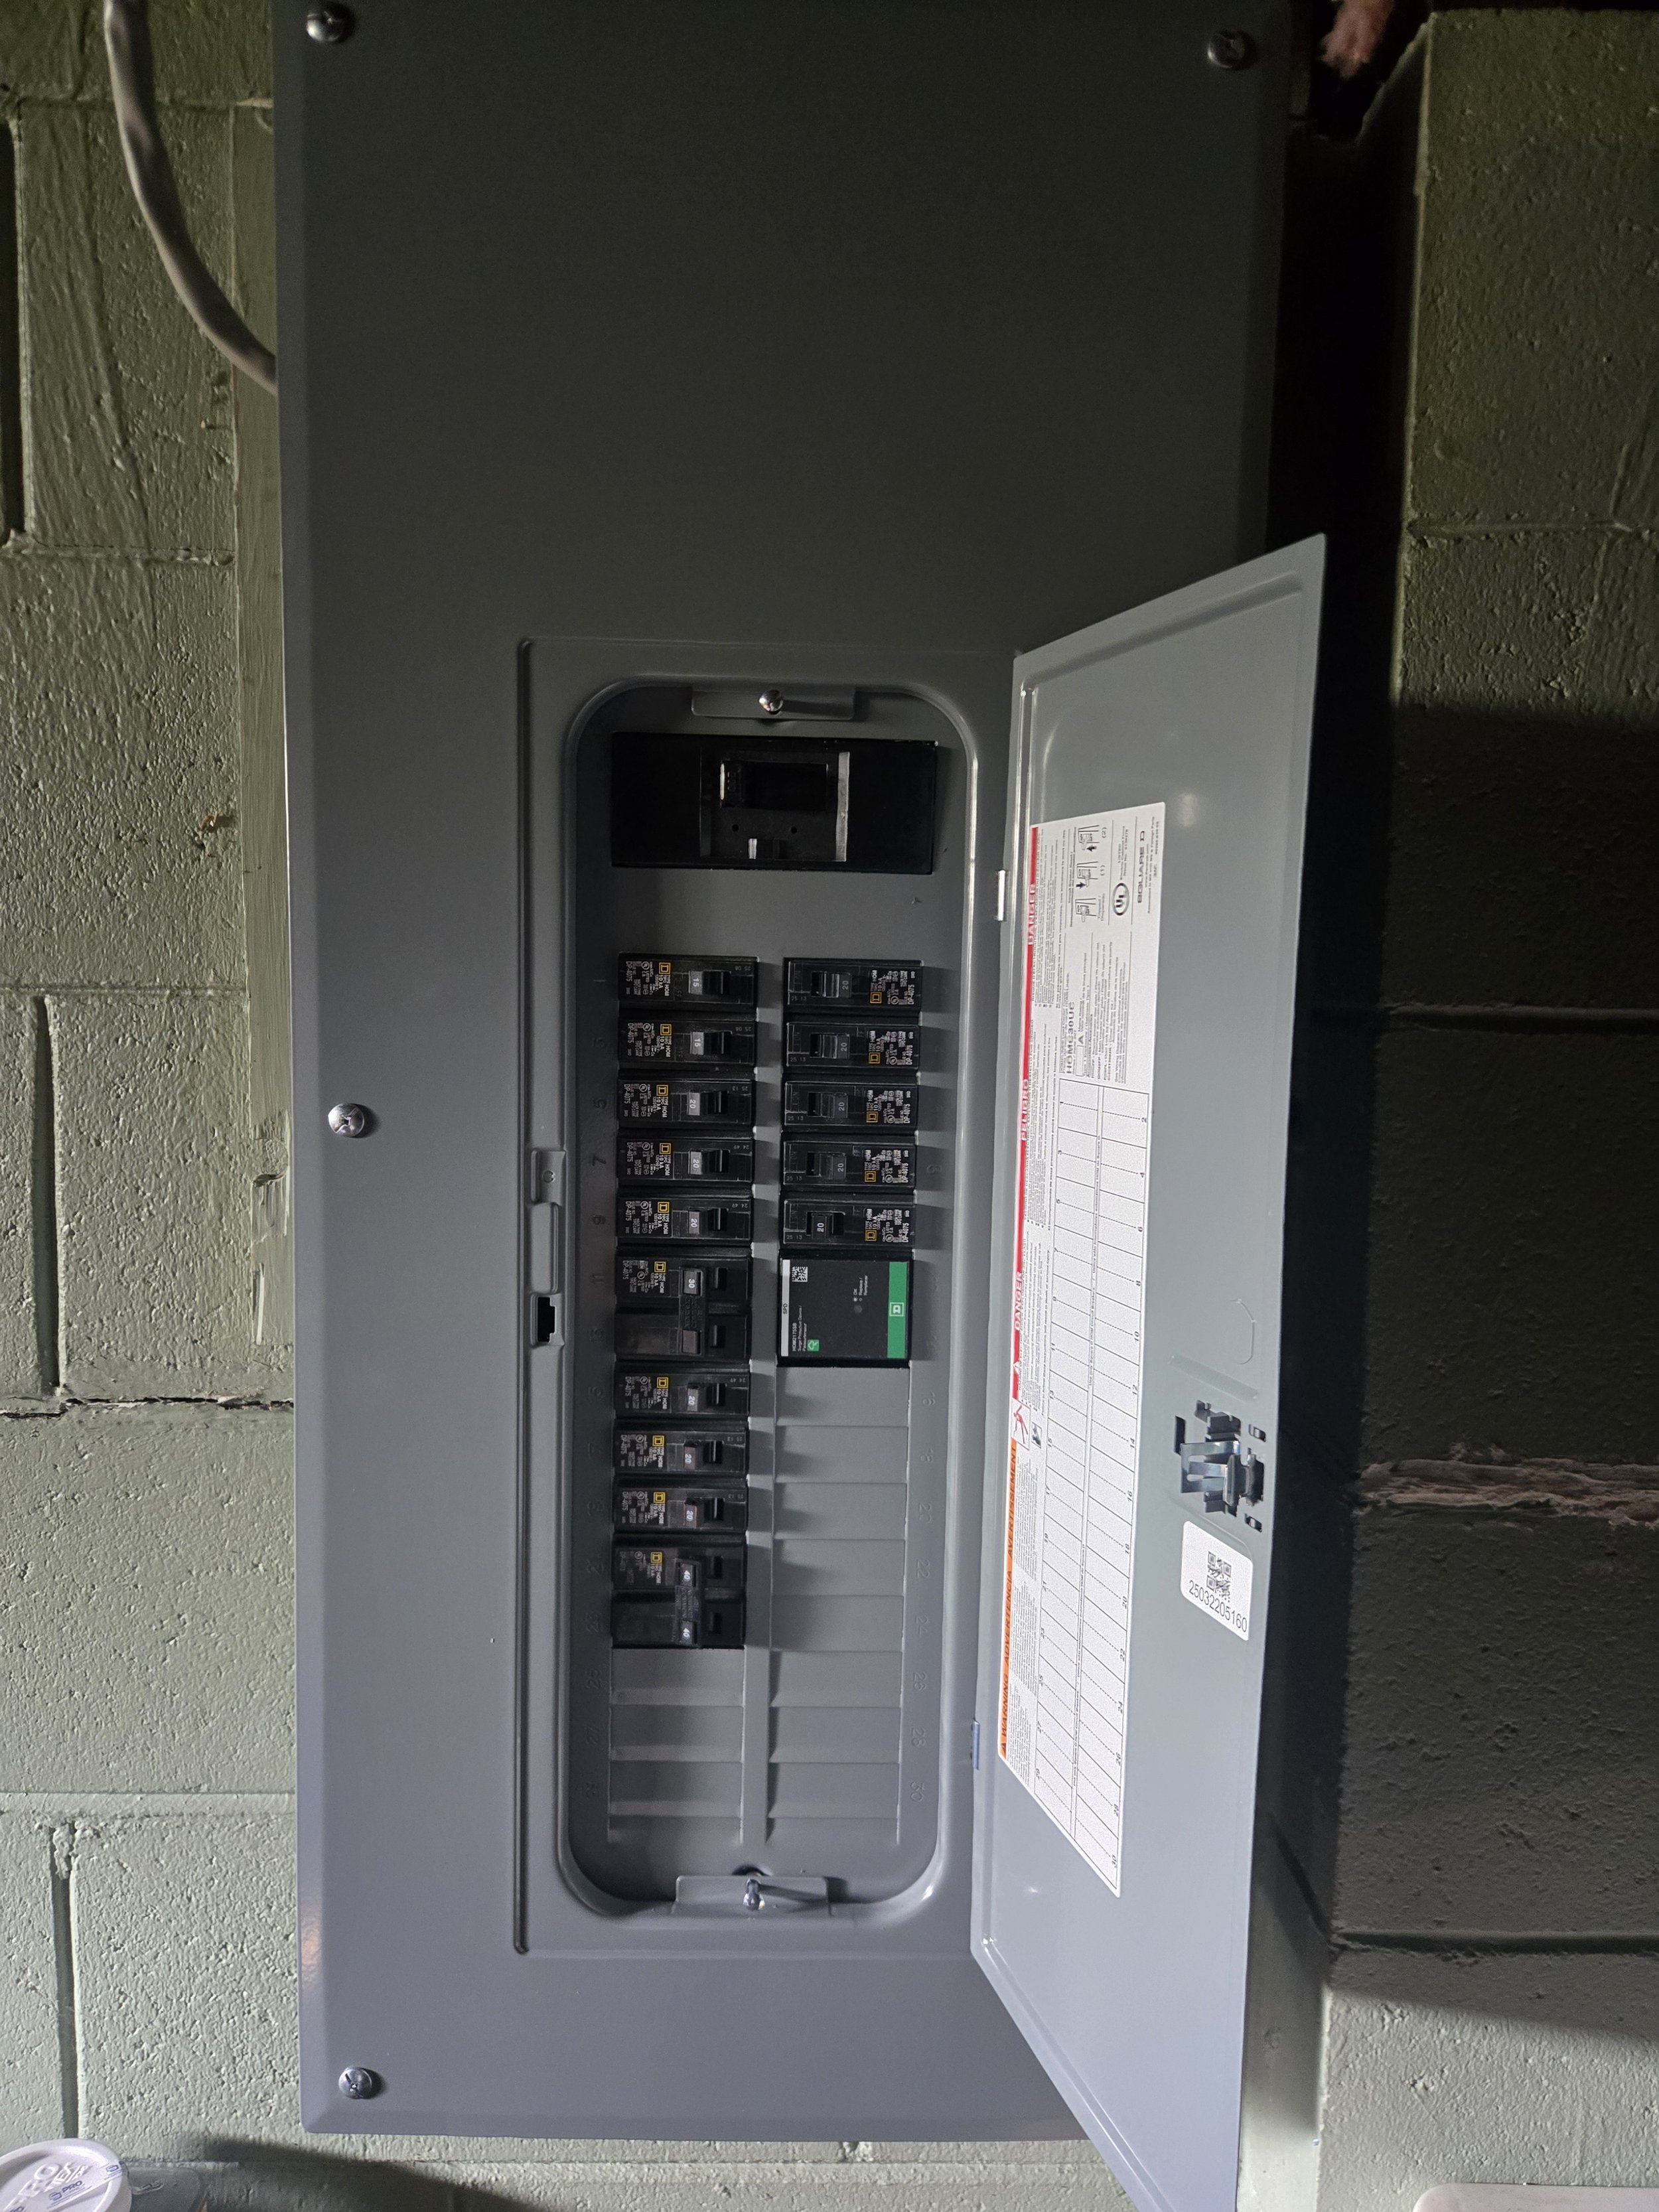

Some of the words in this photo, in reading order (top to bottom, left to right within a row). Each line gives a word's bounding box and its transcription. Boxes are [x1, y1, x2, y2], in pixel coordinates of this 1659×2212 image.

[1139, 830, 1145, 842] D
[693, 978, 699, 987] 15
[842, 980, 849, 990] 20
[694, 1038, 701, 1047] 15
[841, 1043, 847, 1052] 20
[689, 1099, 696, 1109] 20
[838, 1102, 845, 1111] 20
[592, 1153, 607, 1167] 7
[693, 1159, 699, 1168] 20
[837, 1163, 843, 1172] 20
[591, 1215, 606, 1226] 9
[691, 1218, 697, 1228] 20
[817, 1222, 824, 1232] 20
[689, 1279, 695, 1288] 30
[1134, 1331, 1139, 1341] 10
[1131, 1384, 1137, 1395] 12
[688, 1396, 695, 1406] 20
[1129, 1438, 1135, 1449] 14
[685, 1453, 692, 1464] 20
[1127, 1490, 1133, 1502] 16
[686, 1511, 693, 1520] 20
[1124, 1543, 1130, 1554] 18
[916, 1559, 930, 1578] 22
[684, 1570, 691, 1581] 40
[1122, 1595, 1127, 1609] 20
[1189, 1580, 1247, 1633] 25032205160
[1003, 1571, 1012, 1664] ADVERTENCIA
[683, 1627, 690, 1637] 40
[1119, 1648, 1125, 1662] 22
[913, 1672, 928, 1692] 26
[1118, 1700, 1123, 1714] 24
[1116, 1752, 1121, 1766] 26
[910, 1782, 925, 1802] 30
[1114, 1803, 1119, 1817] 28
[1112, 1854, 1118, 1868] 30
[62, 2180, 82, 2193] PRO
